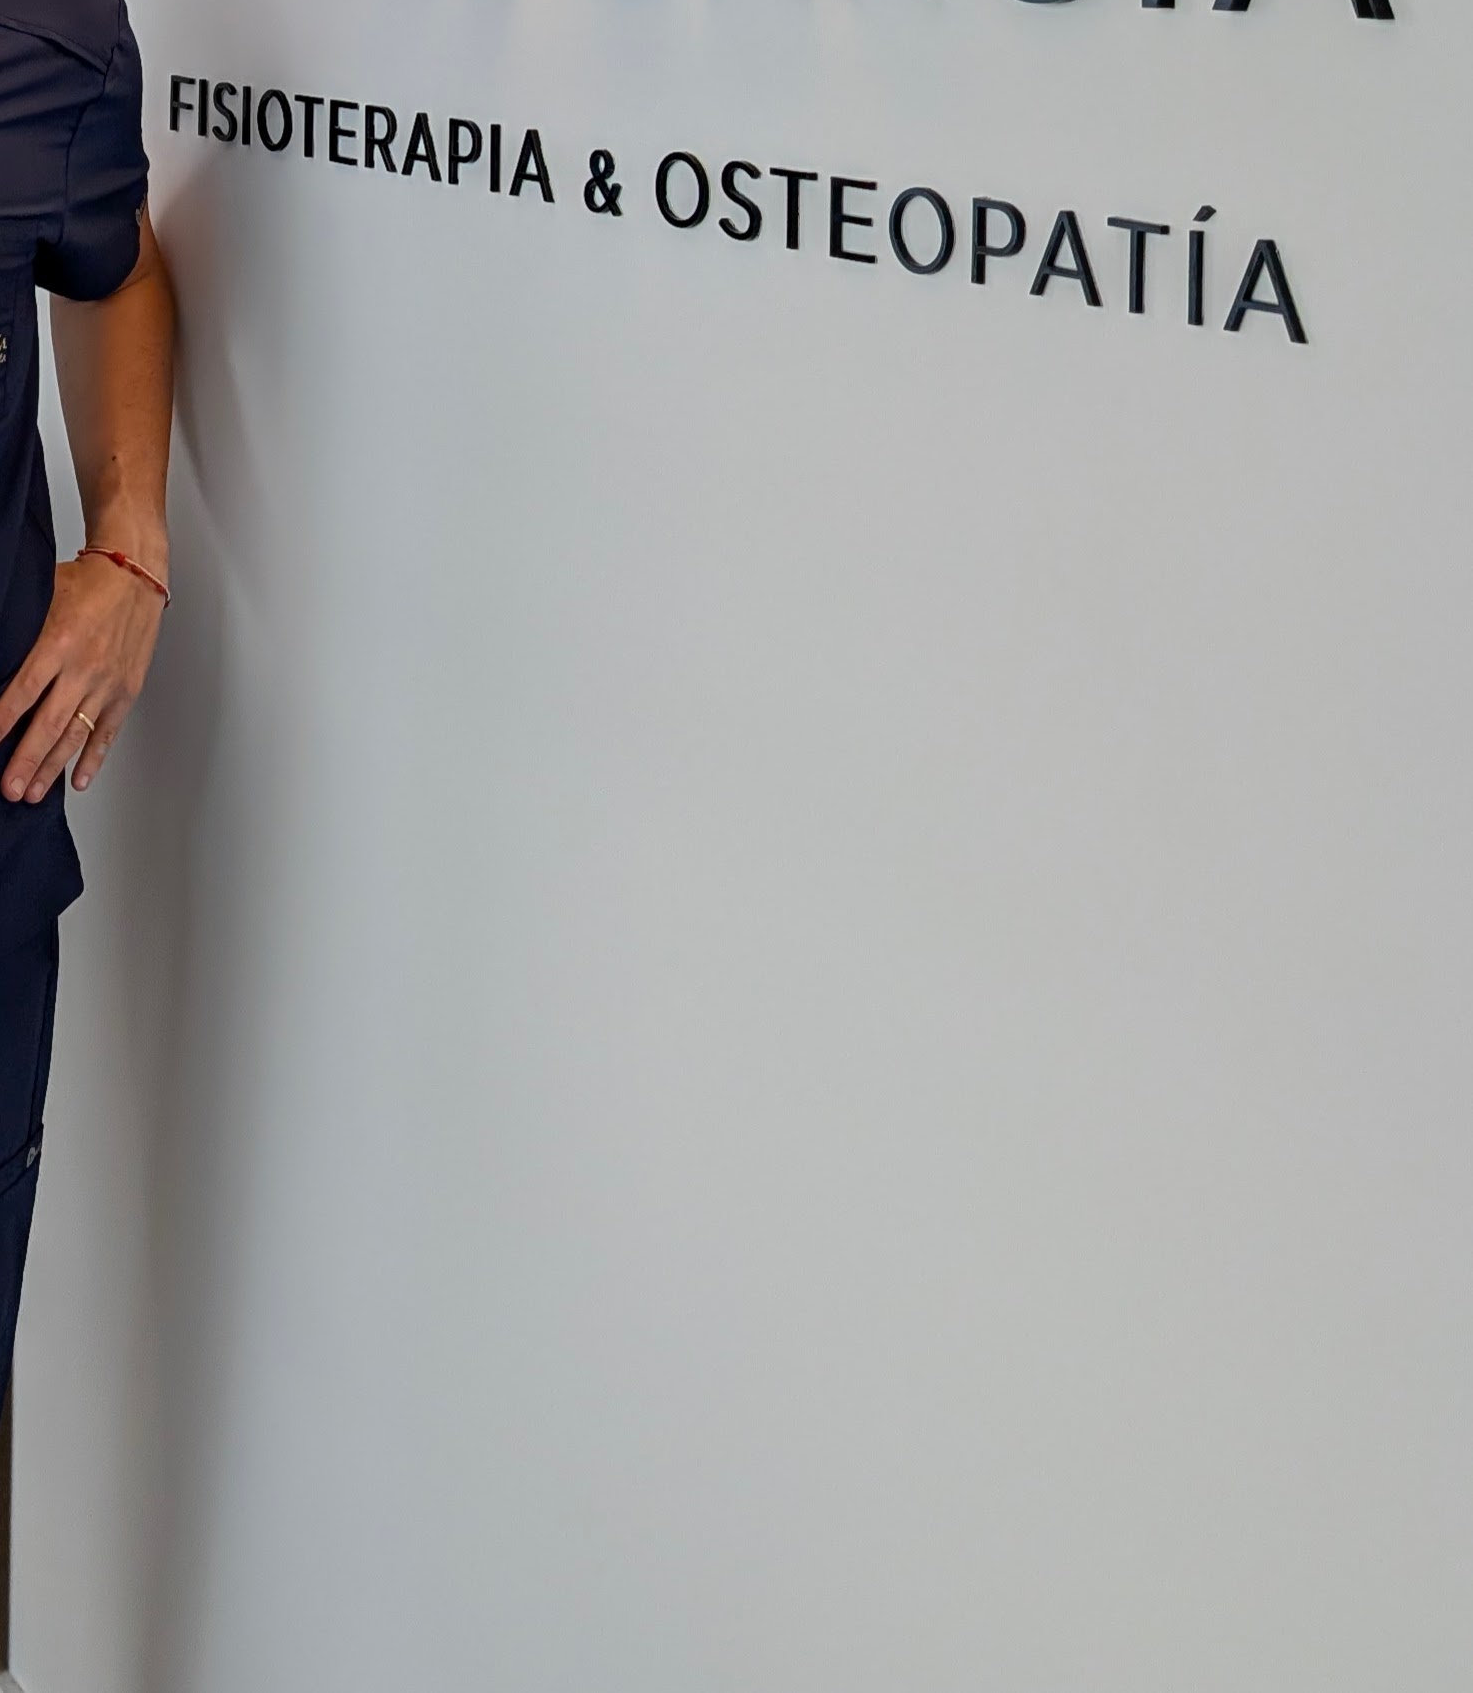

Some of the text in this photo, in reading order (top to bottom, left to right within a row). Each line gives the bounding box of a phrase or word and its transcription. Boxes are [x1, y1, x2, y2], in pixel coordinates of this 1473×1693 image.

[168, 74, 1310, 345] FISIOTERAPIA & OSTEOPATÍA
